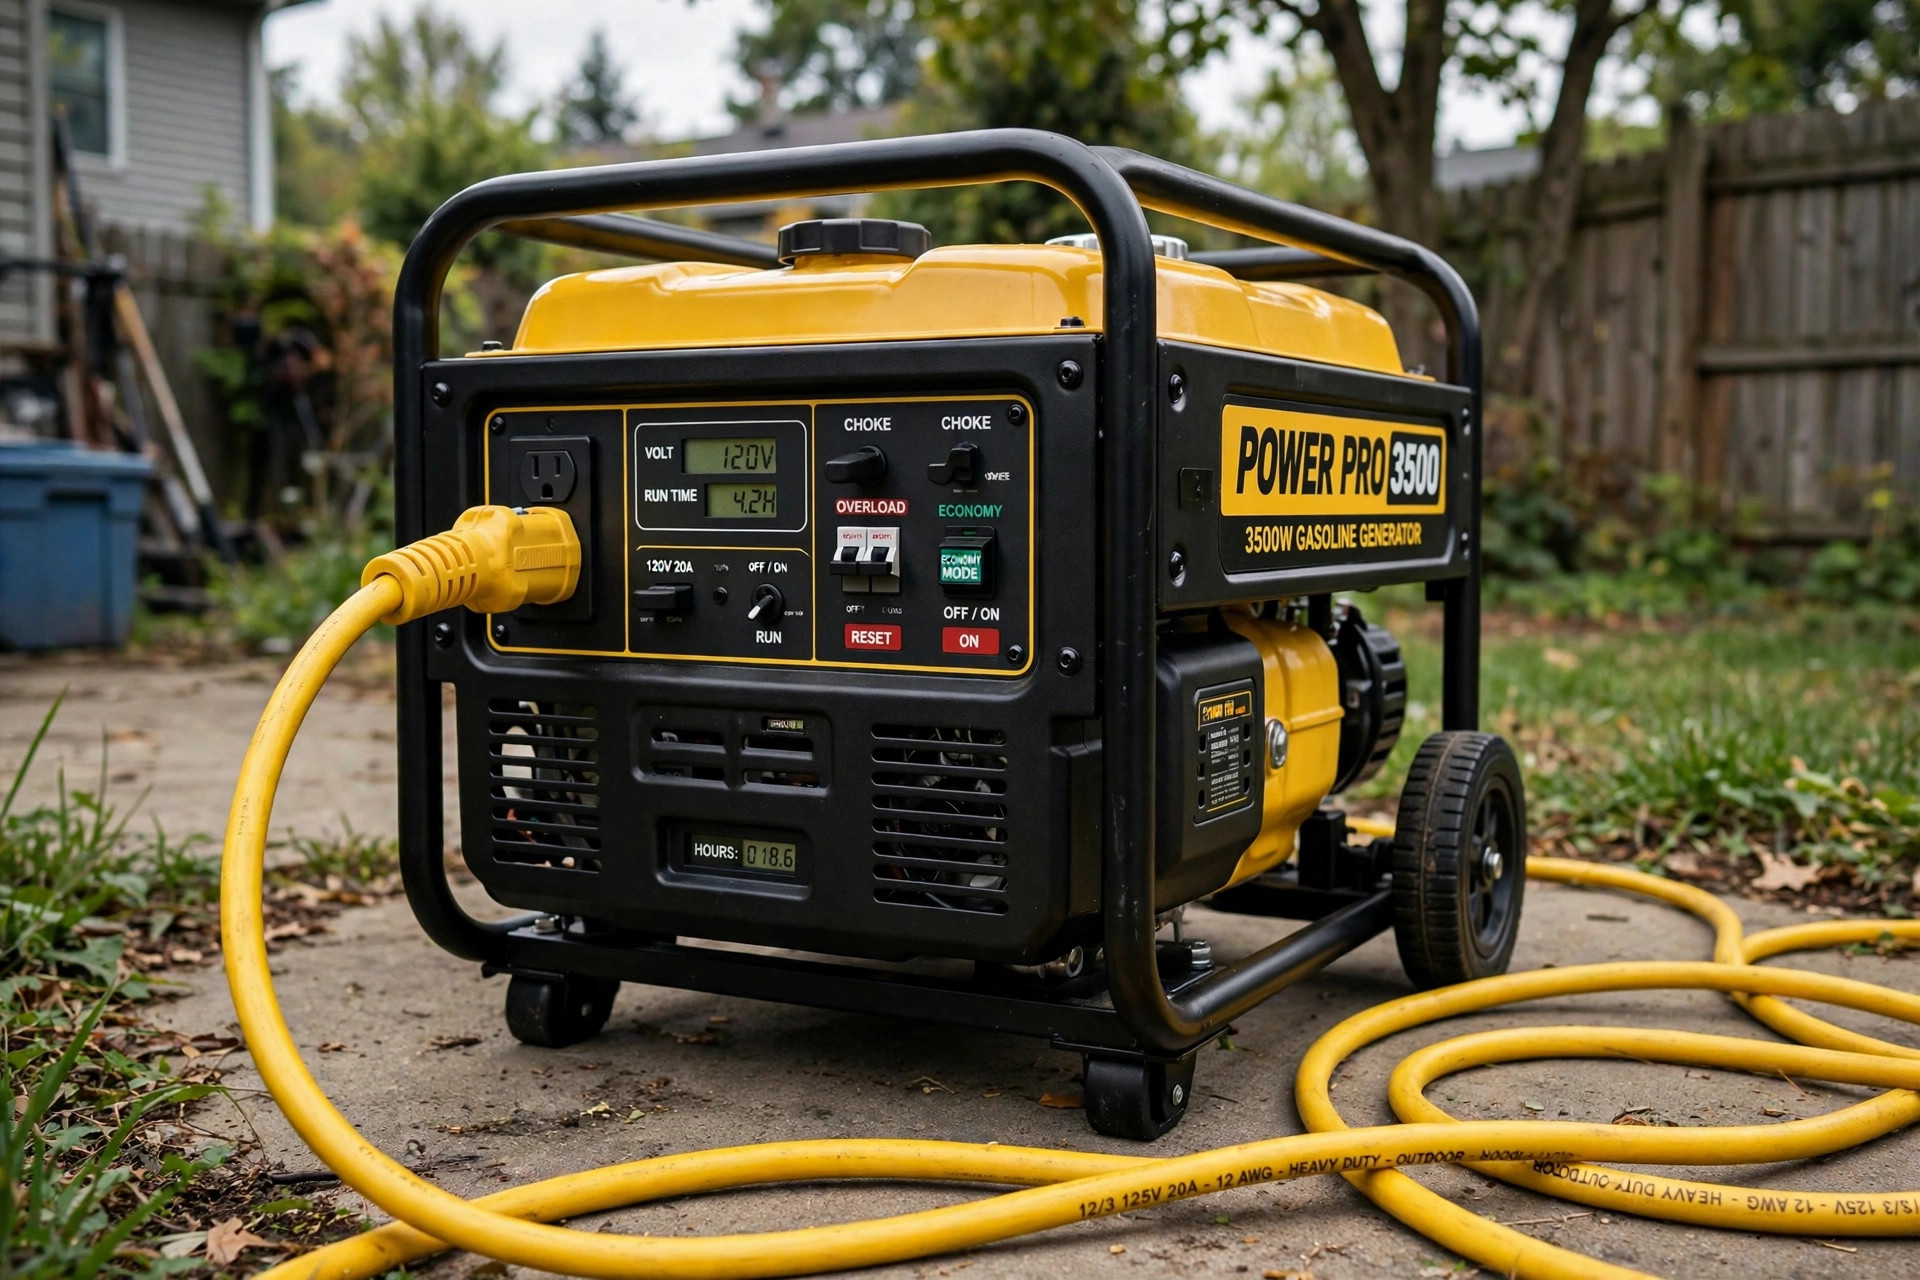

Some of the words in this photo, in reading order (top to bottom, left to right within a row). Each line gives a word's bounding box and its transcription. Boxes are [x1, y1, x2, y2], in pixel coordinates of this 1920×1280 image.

[844, 417, 892, 432] CHOKE
[941, 415, 992, 430] CHOKE
[644, 446, 675, 460] VOLT
[723, 444, 775, 470] 120V
[1236, 425, 1335, 496] POWER
[1340, 434, 1386, 496] PRO
[1390, 441, 1440, 496] 3500
[644, 489, 669, 503] RUN
[670, 488, 698, 502] TIME
[733, 489, 776, 514] 4.2H
[836, 500, 906, 514] OVERLOAD
[938, 504, 1003, 518] ECONOMY
[1244, 525, 1294, 554] 3500W
[1296, 523, 1357, 552] GASOLINE
[1359, 522, 1423, 548] GENERATOR
[646, 559, 673, 573] 120V
[673, 560, 694, 573] 20A
[748, 561, 765, 573] OFF
[773, 561, 788, 573] ON
[942, 566, 979, 580] MODE
[943, 606, 969, 620] OFF
[980, 607, 1000, 621] ON
[756, 630, 782, 644] RUN
[851, 630, 893, 645] RESET
[959, 634, 979, 648] ON
[694, 842, 739, 860] HOURS:
[1079, 1198, 1116, 1218] 12/3
[1122, 1186, 1162, 1207] 125V
[1167, 1179, 1198, 1199] 20A
[1216, 1172, 1234, 1188] 12
[1237, 1165, 1273, 1186] AWG
[1289, 1157, 1339, 1175] HEAVY
[1343, 1154, 1382, 1169] DUTY
[1396, 1150, 1465, 1166] OUTDOOR
[1614, 1178, 1656, 1197] DUTY
[1661, 1185, 1722, 1206] HEAVY
[1747, 1195, 1788, 1213] AWG
[1794, 1198, 1814, 1214] 12
[1835, 1200, 1876, 1216] 125V
